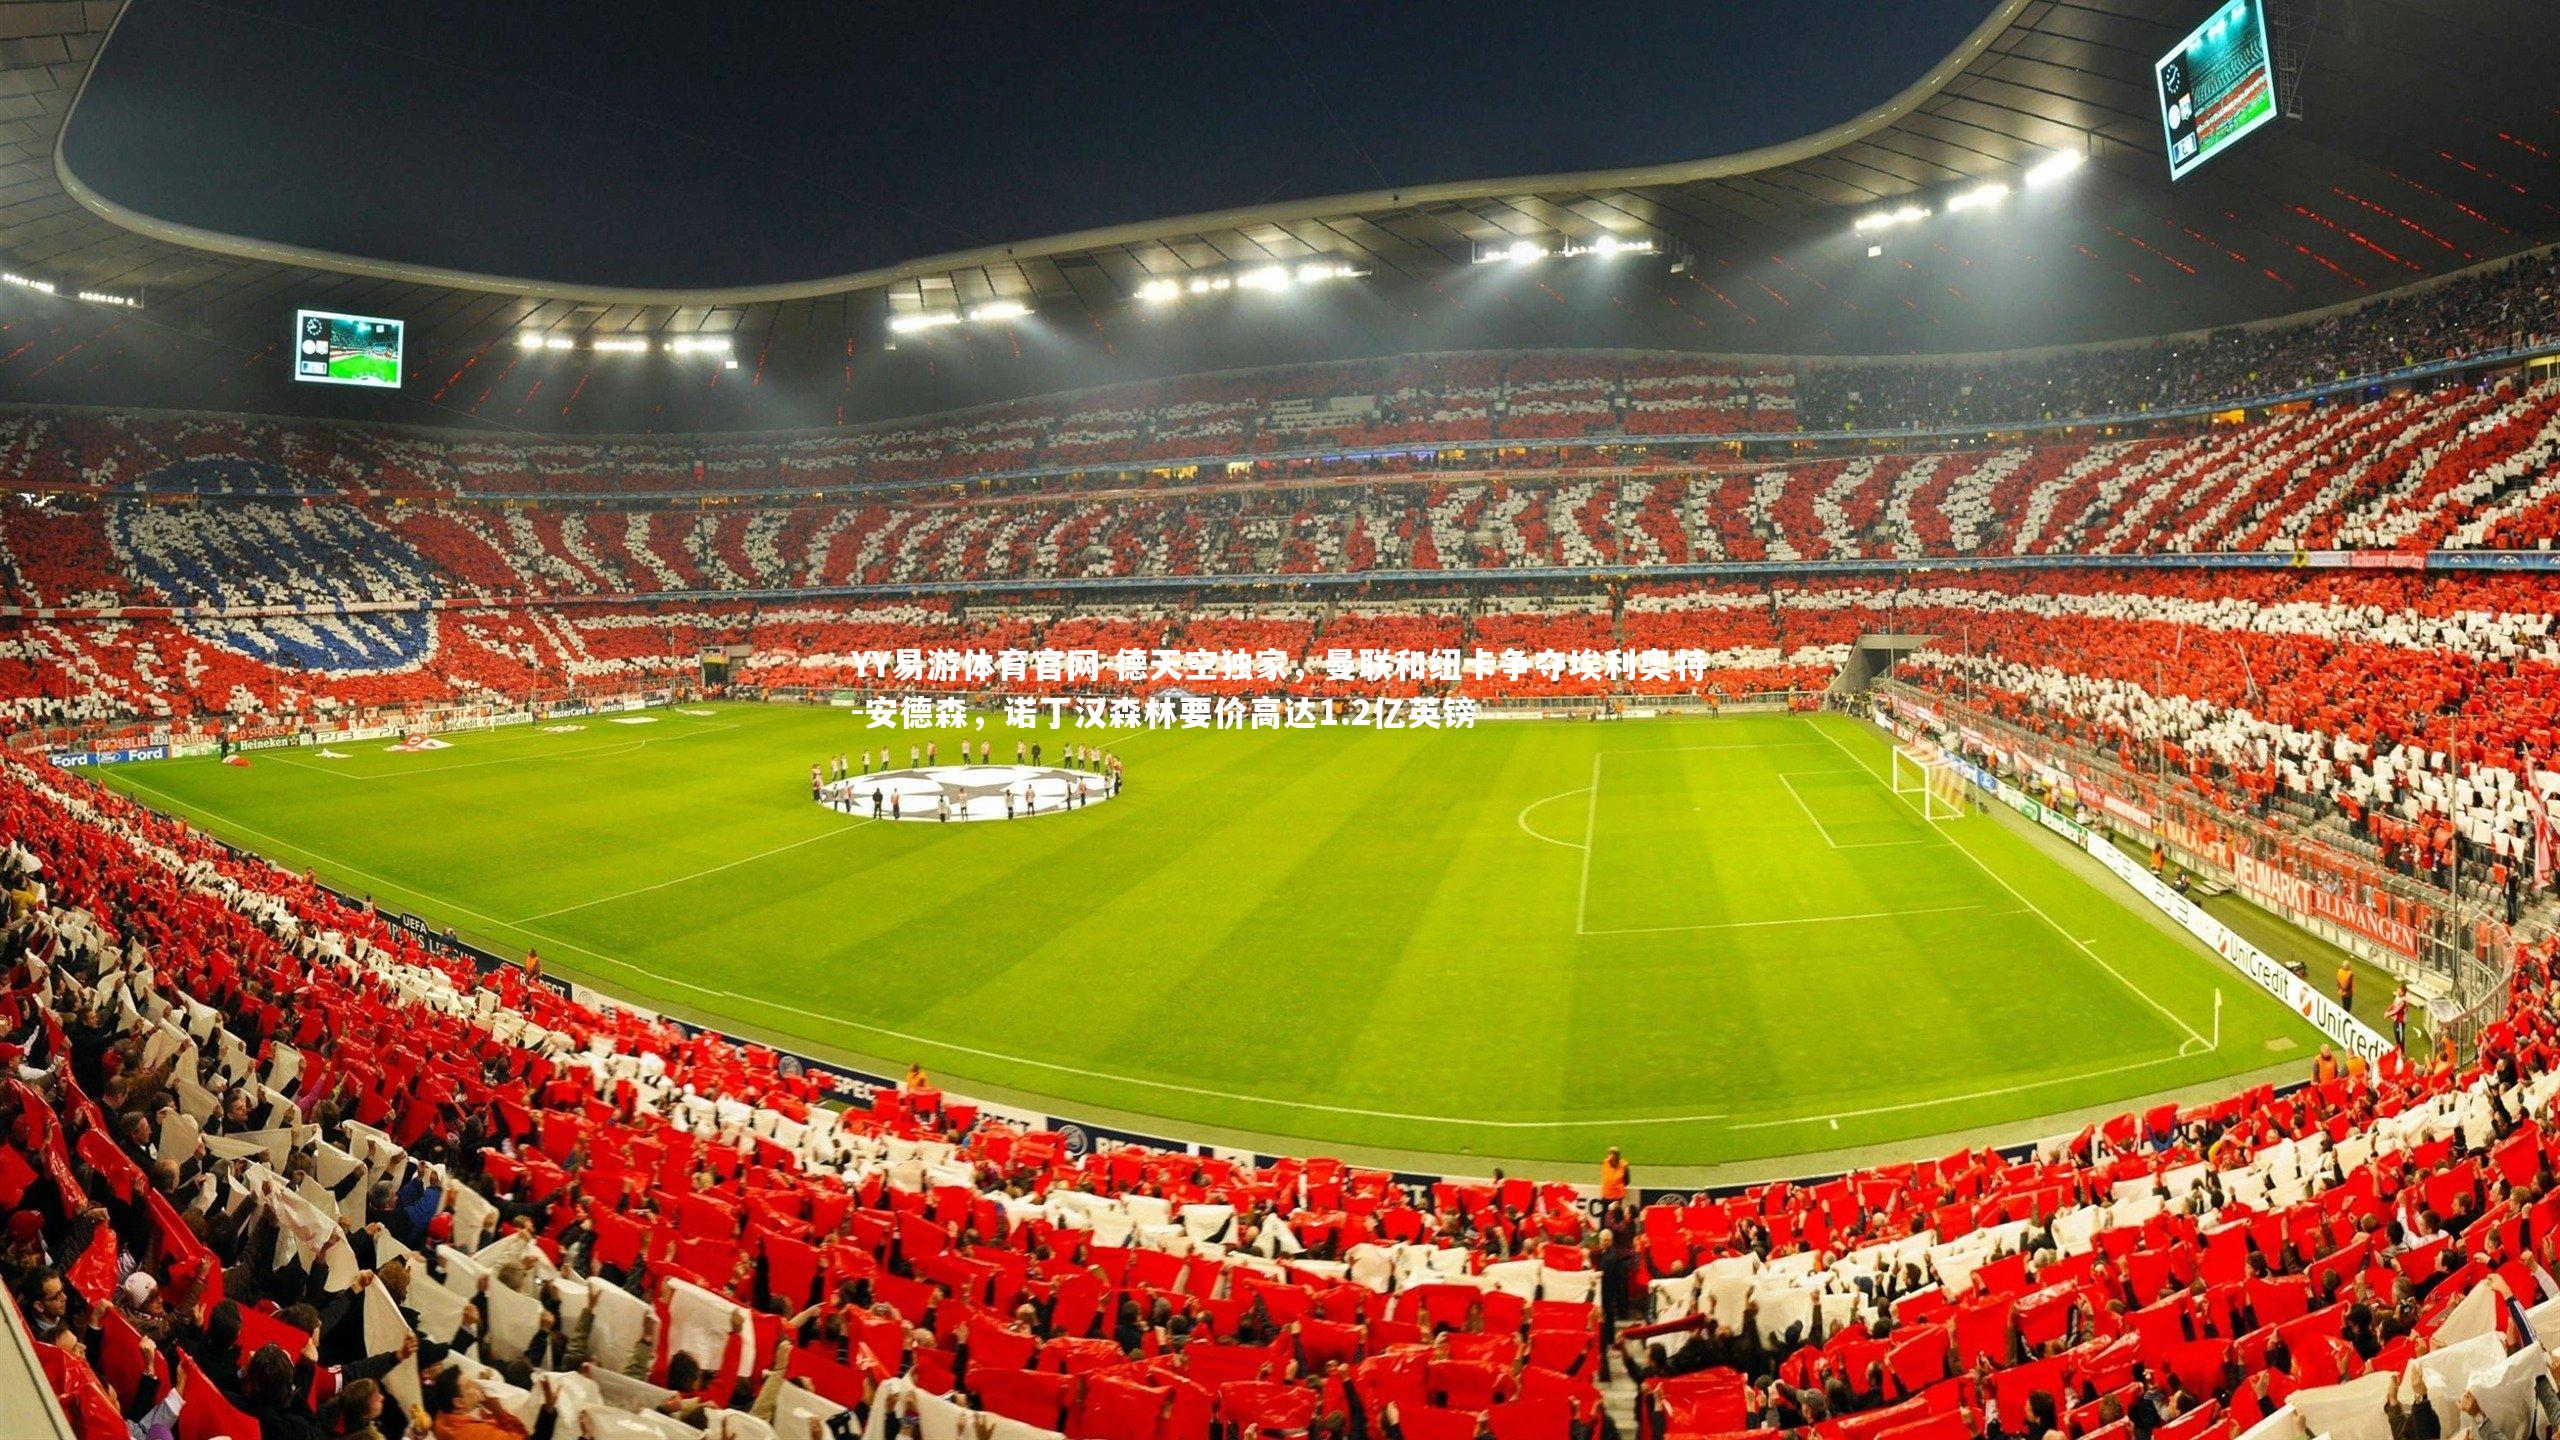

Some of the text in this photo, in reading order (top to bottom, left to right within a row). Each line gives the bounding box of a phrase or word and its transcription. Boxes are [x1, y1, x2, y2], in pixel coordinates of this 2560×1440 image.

[52, 754, 88, 767] Ford
[128, 748, 163, 761] Ford
[240, 738, 289, 751] Heineken
[2234, 852, 2312, 914] NEUMARKT
[402, 915, 428, 935] UEFA
[2316, 889, 2416, 952] ELLWANGEN
[2230, 936, 2289, 1000] UniCredit
